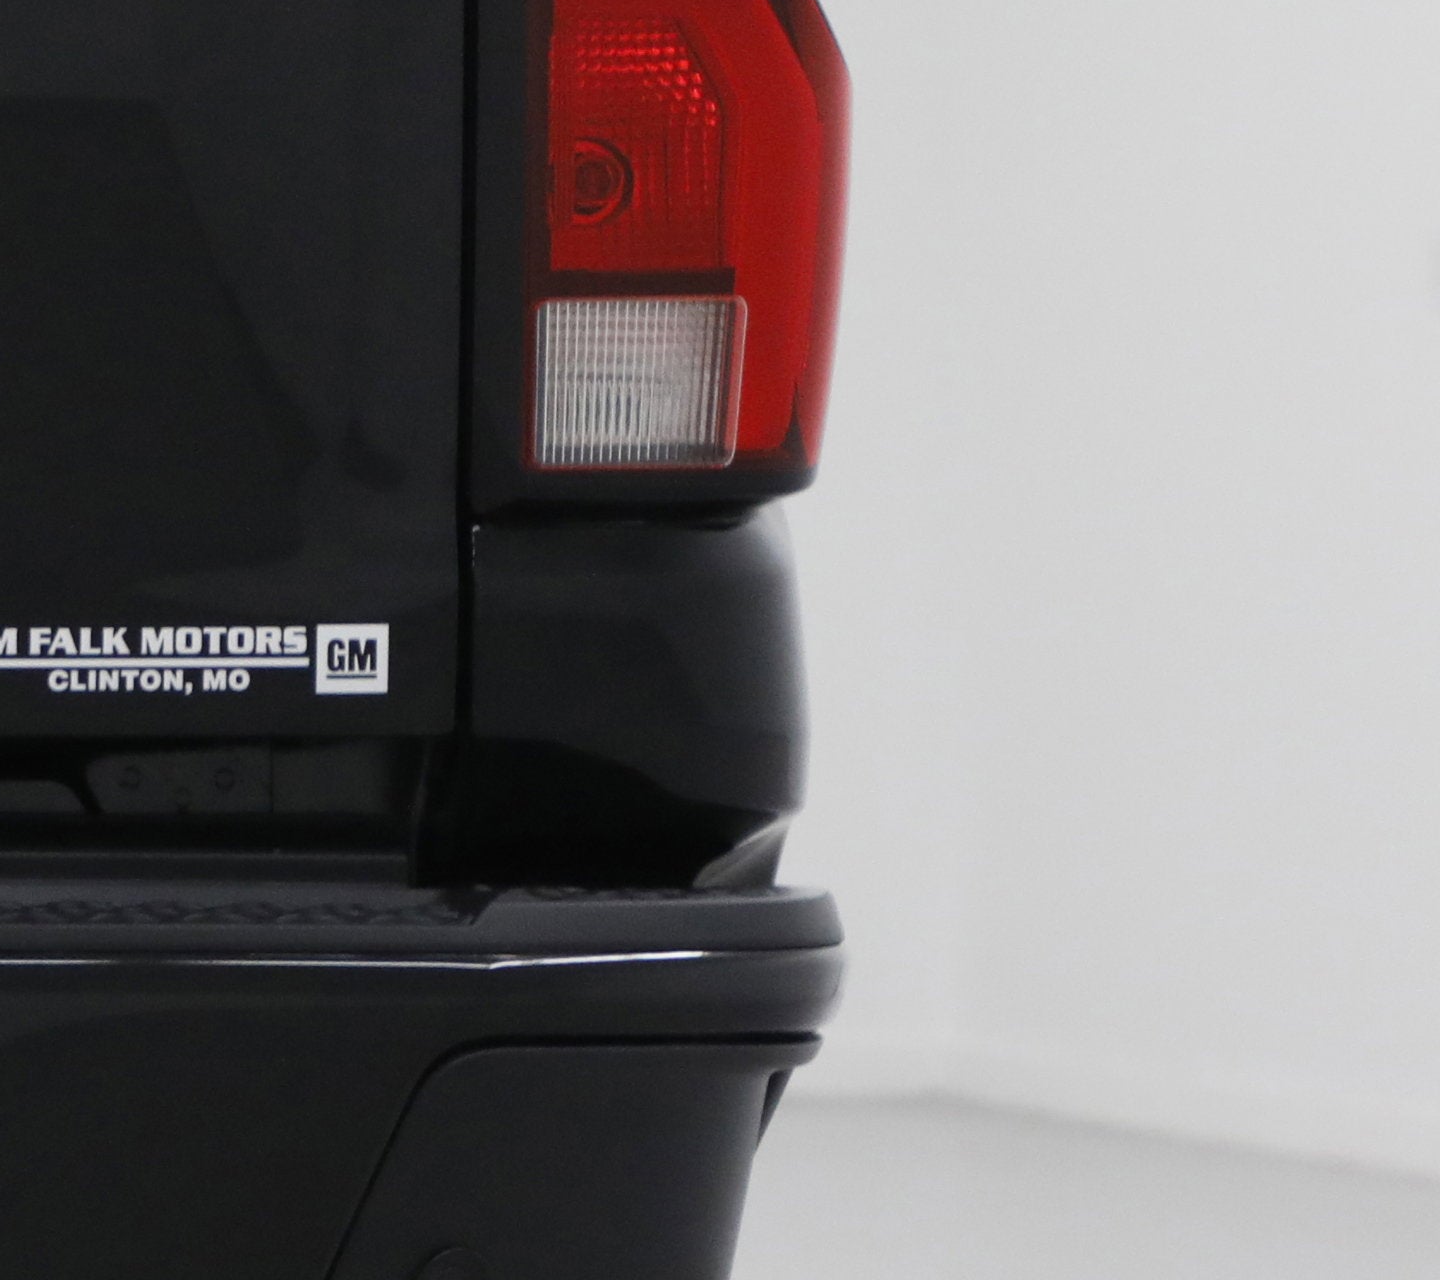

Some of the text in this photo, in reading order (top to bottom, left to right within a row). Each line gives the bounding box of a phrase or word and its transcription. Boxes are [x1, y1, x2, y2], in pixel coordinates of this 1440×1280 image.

[28, 626, 131, 656] FALK
[140, 625, 308, 656] MOTORS
[327, 639, 377, 673] GM
[47, 668, 251, 696] CLINTON, MO
